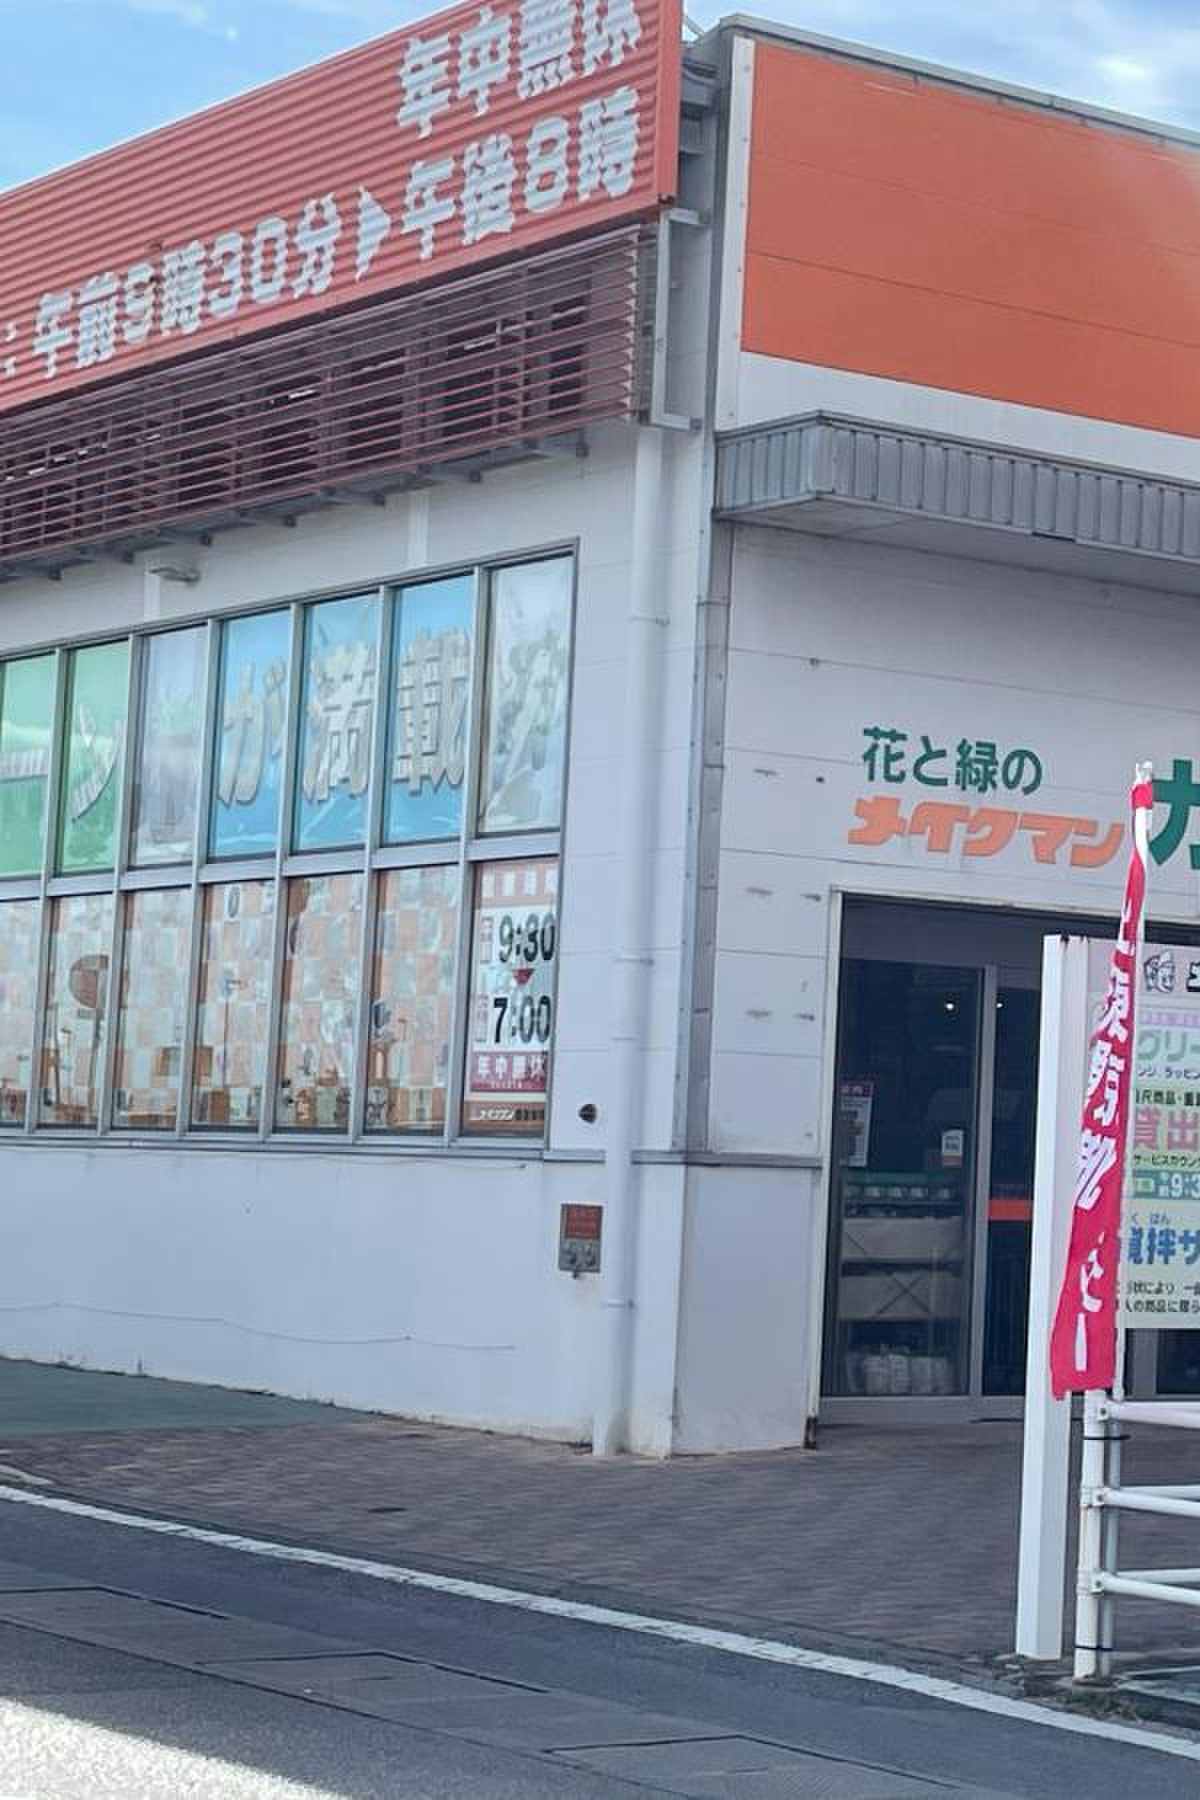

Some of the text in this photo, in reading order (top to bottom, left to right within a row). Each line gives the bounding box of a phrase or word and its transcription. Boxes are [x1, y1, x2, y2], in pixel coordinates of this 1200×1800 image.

[862, 727, 1043, 795] 花と緑の
[847, 795, 1125, 868] メイクマン
[498, 913, 556, 963] 9:30
[493, 996, 550, 1043] 7:00
